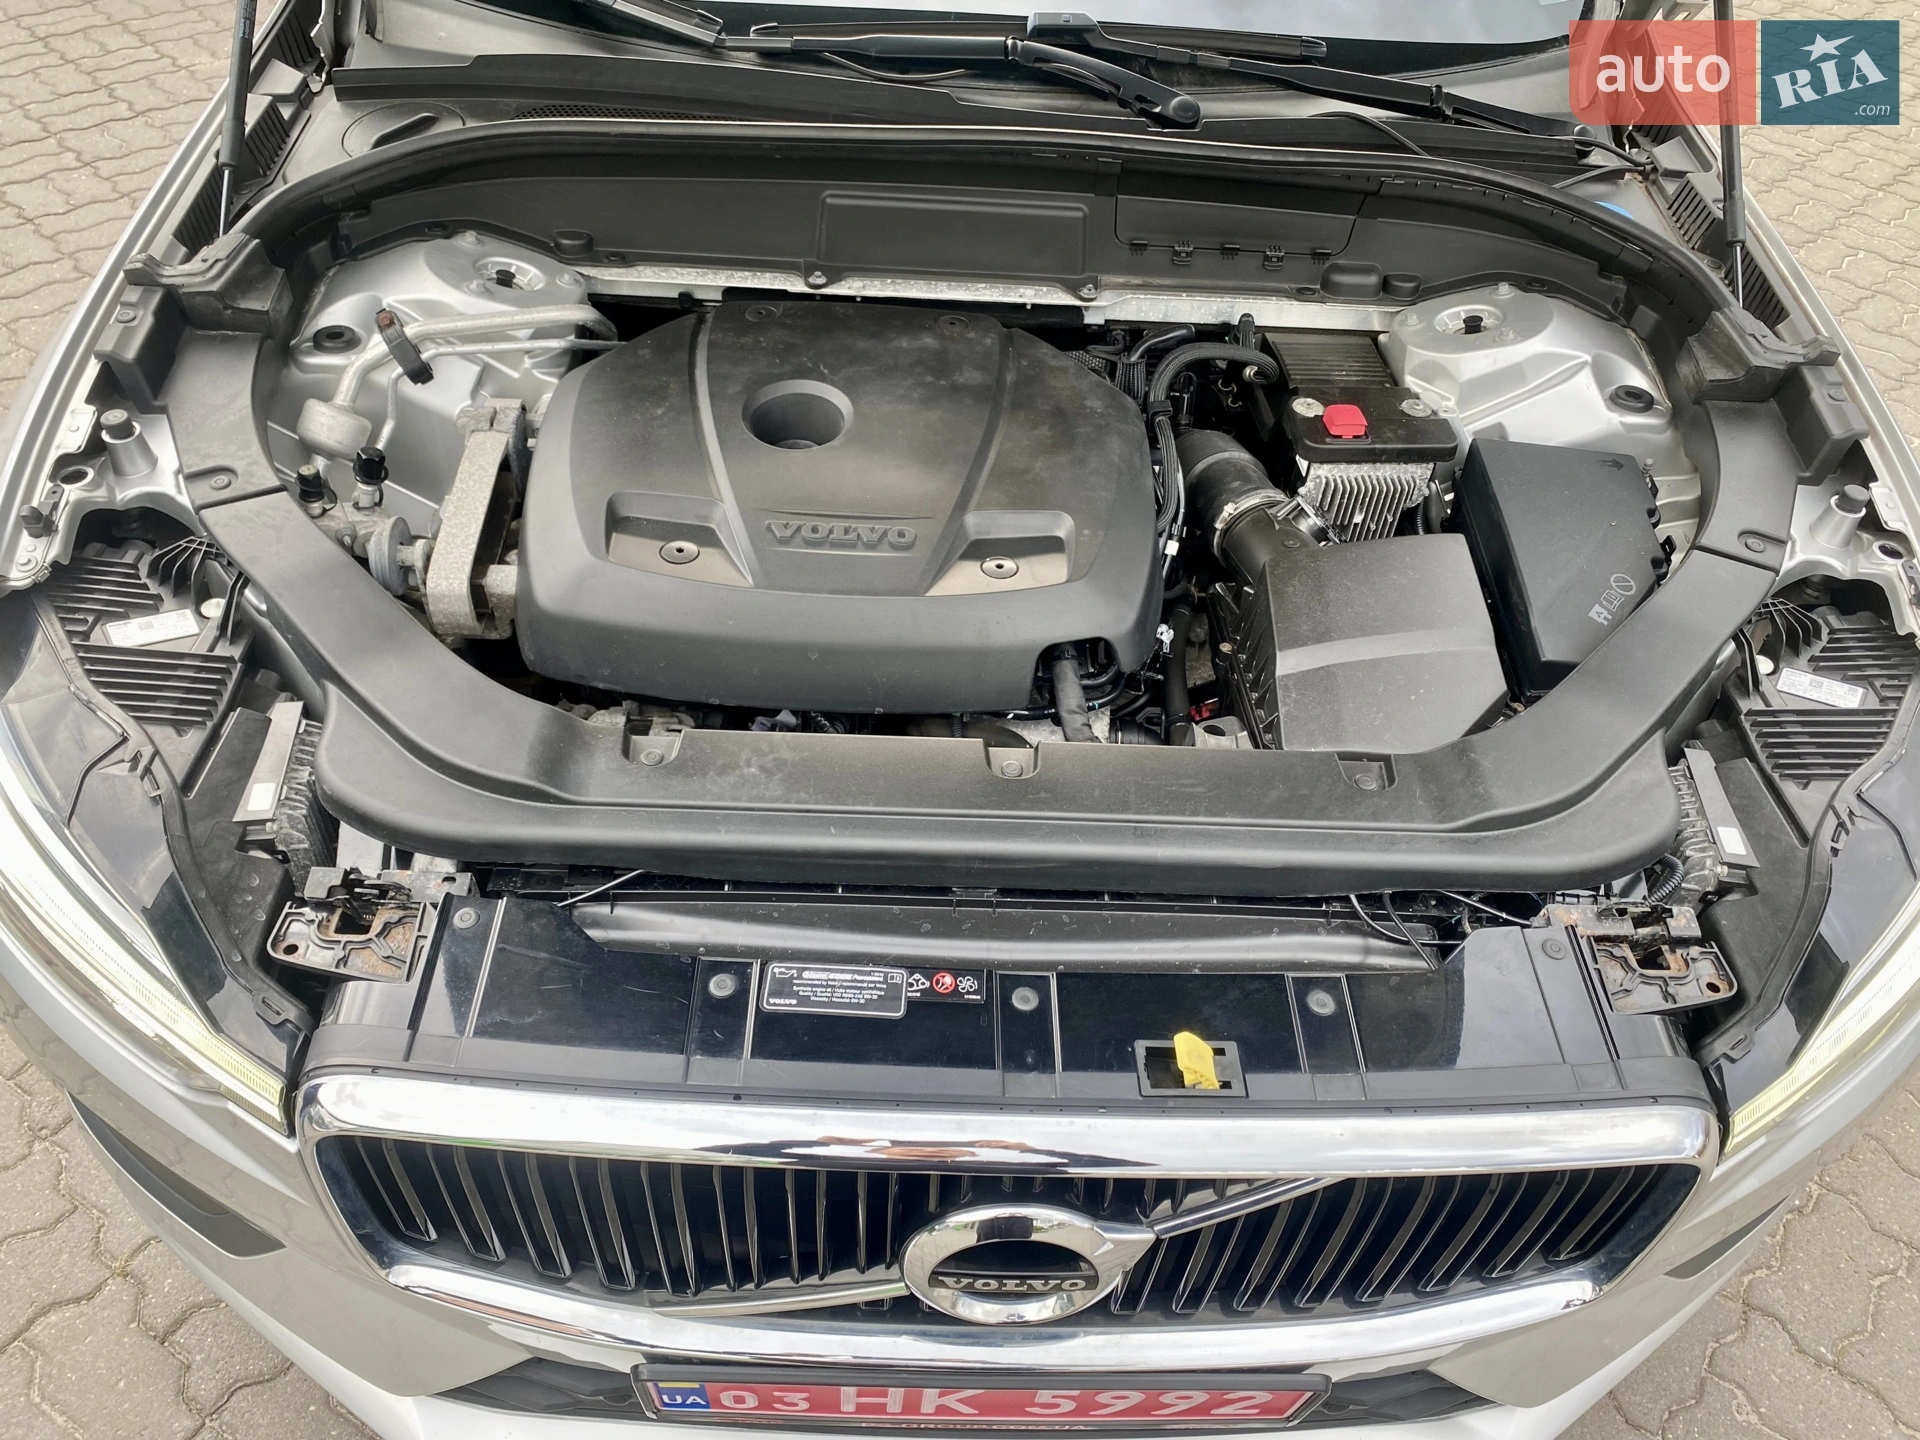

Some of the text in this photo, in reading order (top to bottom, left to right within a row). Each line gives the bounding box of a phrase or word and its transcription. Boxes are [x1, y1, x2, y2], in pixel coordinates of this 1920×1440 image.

[765, 520, 917, 548] VOLVO
[938, 1276, 1087, 1292] VOLVO
[661, 1394, 707, 1405] UA
[719, 1387, 1274, 1415] 03 HK 5992
